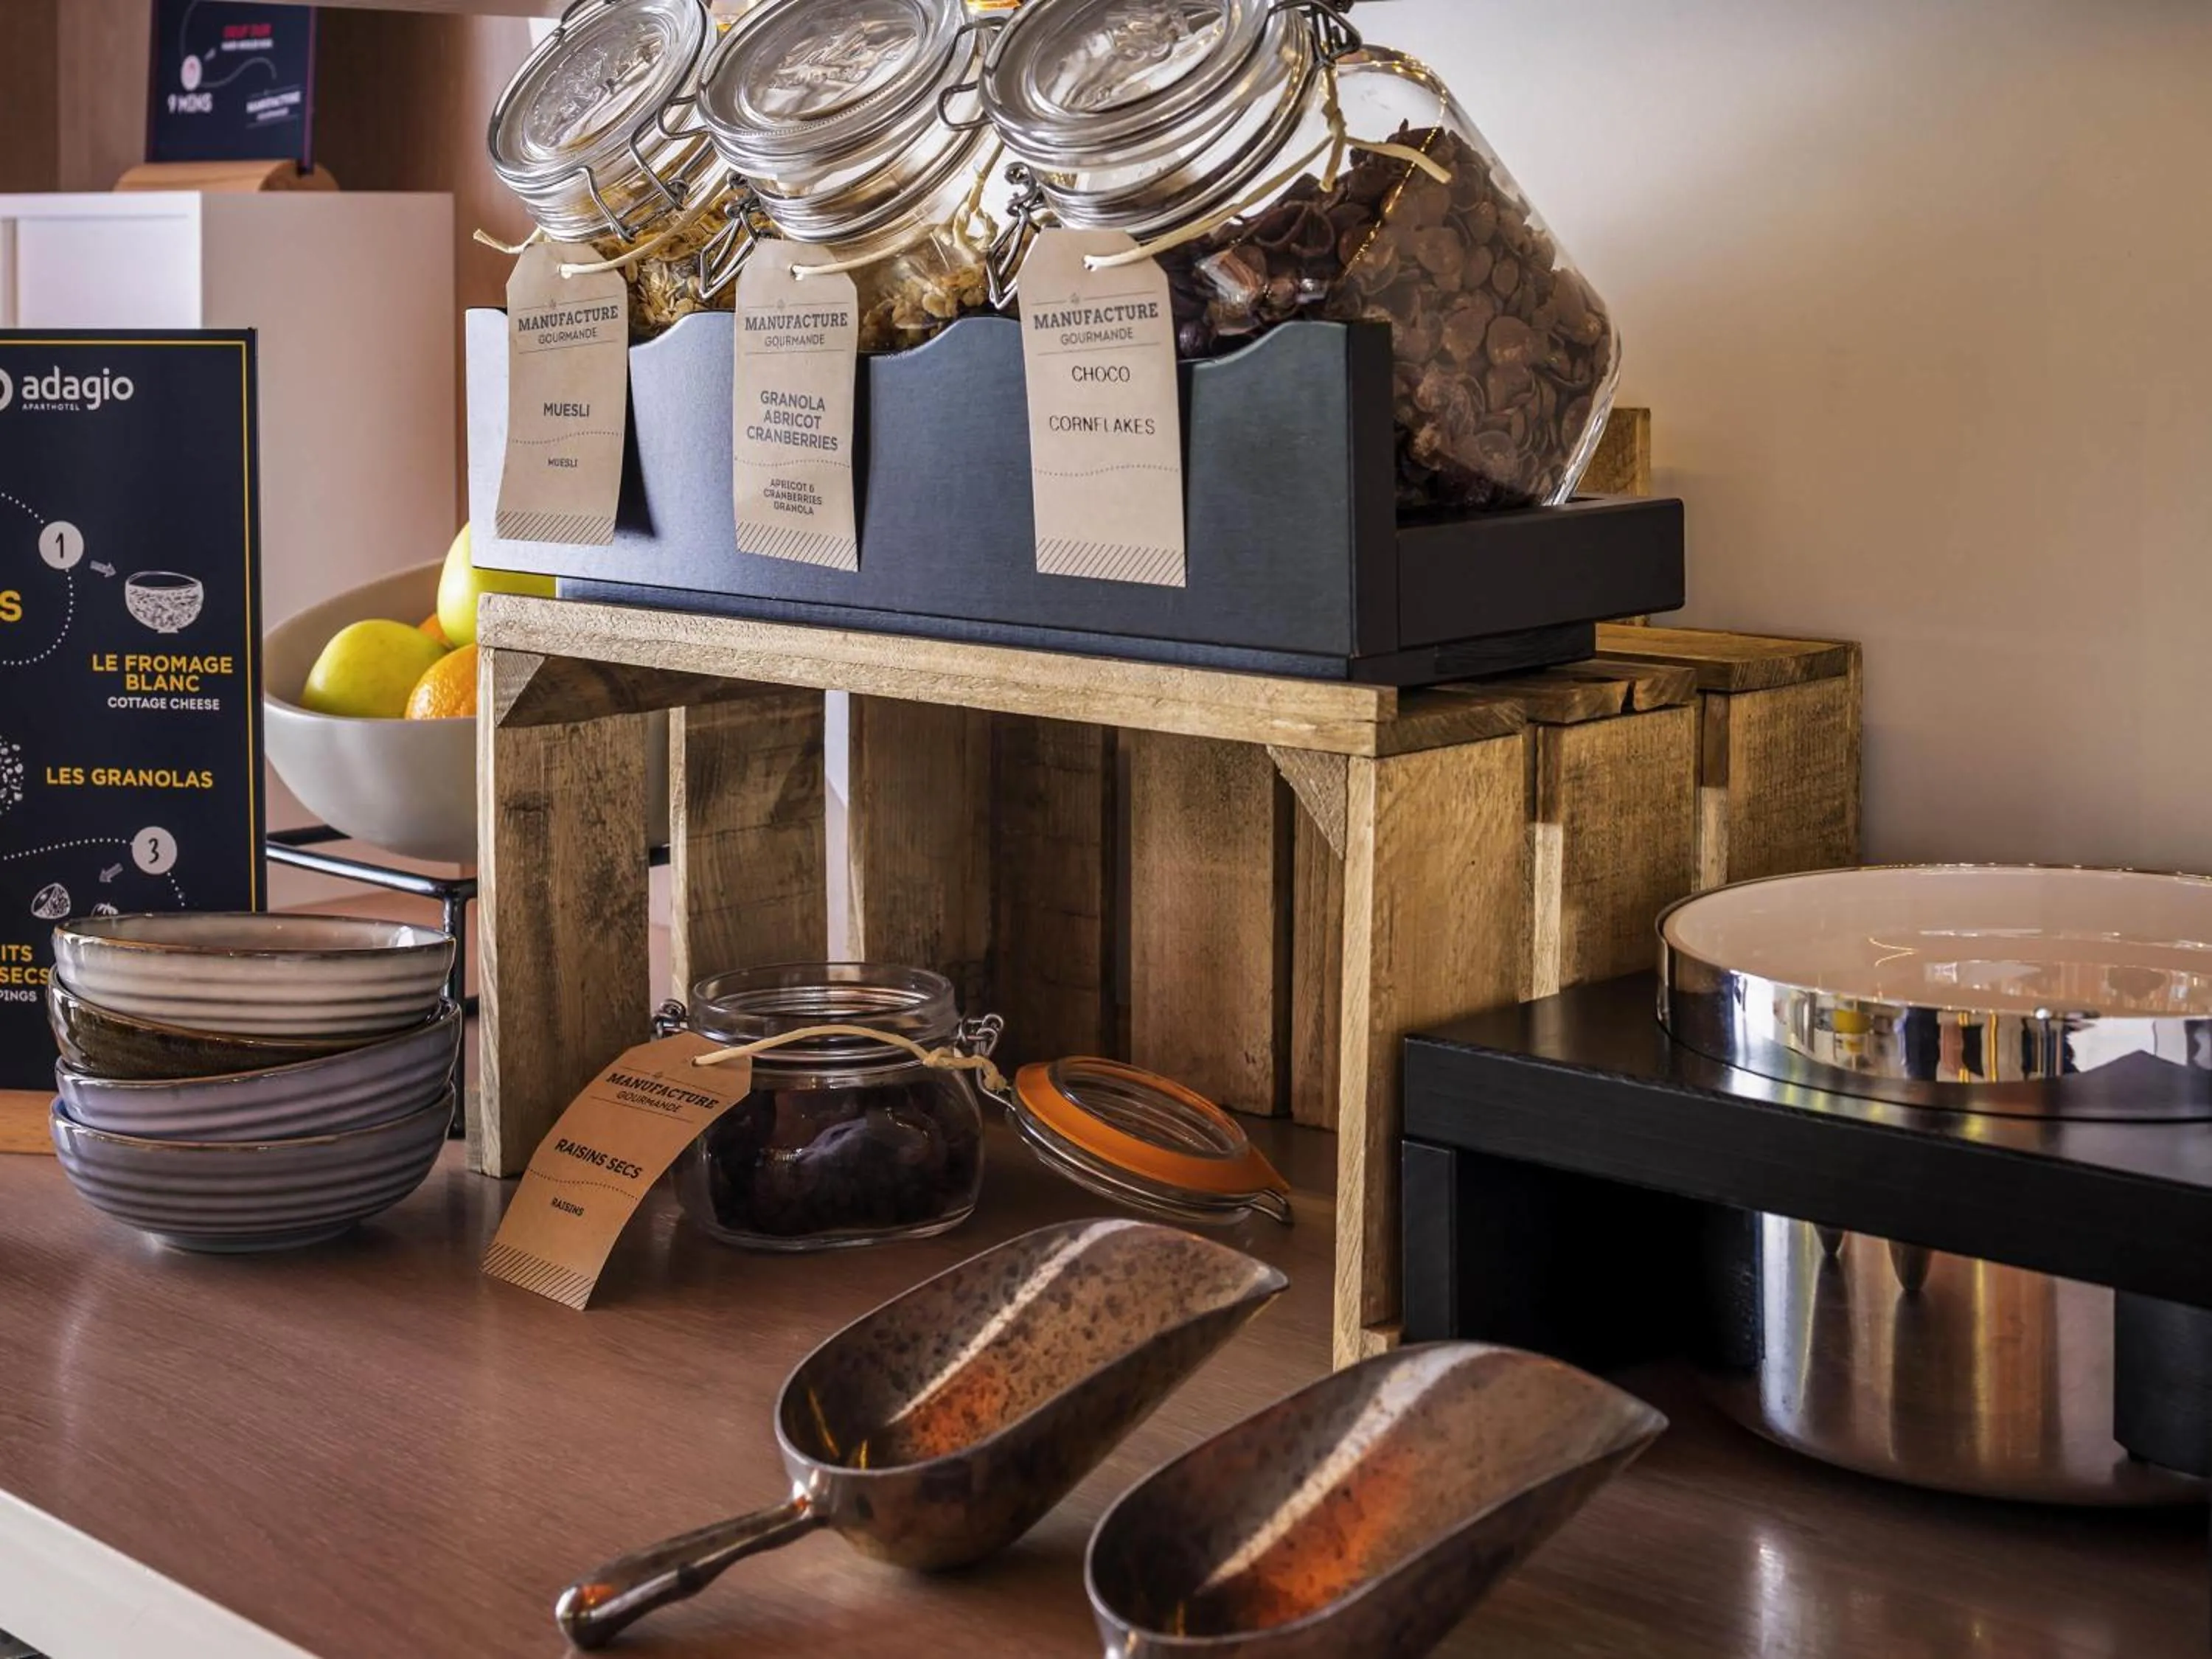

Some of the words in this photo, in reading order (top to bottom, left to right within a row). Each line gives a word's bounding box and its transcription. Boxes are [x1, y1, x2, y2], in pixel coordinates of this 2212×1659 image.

[518, 305, 619, 332] MANUFACTURE
[745, 313, 848, 331] MANUFACTURE
[1034, 302, 1158, 330] MANUFACTURE
[538, 327, 598, 344] GOURMANDE
[765, 334, 825, 347] GOURMANDE
[1061, 327, 1133, 345] GOURMANDE
[1071, 366, 1130, 382] CHOCO
[21, 365, 134, 411] adagio
[543, 403, 590, 417] MUESLI
[760, 390, 825, 411] GRANOLA
[763, 410, 821, 429] ABRICOT
[1049, 415, 1155, 435] CORNFLAKES
[747, 426, 838, 451] CRANBERRIES
[548, 458, 578, 467] MUESLI
[763, 487, 822, 505] CRANBERRIES
[55, 532, 64, 559] 1
[92, 654, 118, 672] LE
[125, 654, 233, 673] FROMAGE
[126, 673, 200, 692] BLANC
[108, 697, 167, 709] COTTAGE
[170, 698, 220, 710] CHEESE
[46, 768, 85, 785] LES
[91, 768, 213, 788] GRANOLAS
[148, 838, 159, 864] 3
[606, 1073, 720, 1110] MANUFACTURE
[616, 1091, 683, 1112] GOURMANDE
[554, 1138, 608, 1166] RAISINS
[606, 1157, 643, 1178] SECS
[552, 1197, 585, 1217] RAISINS
